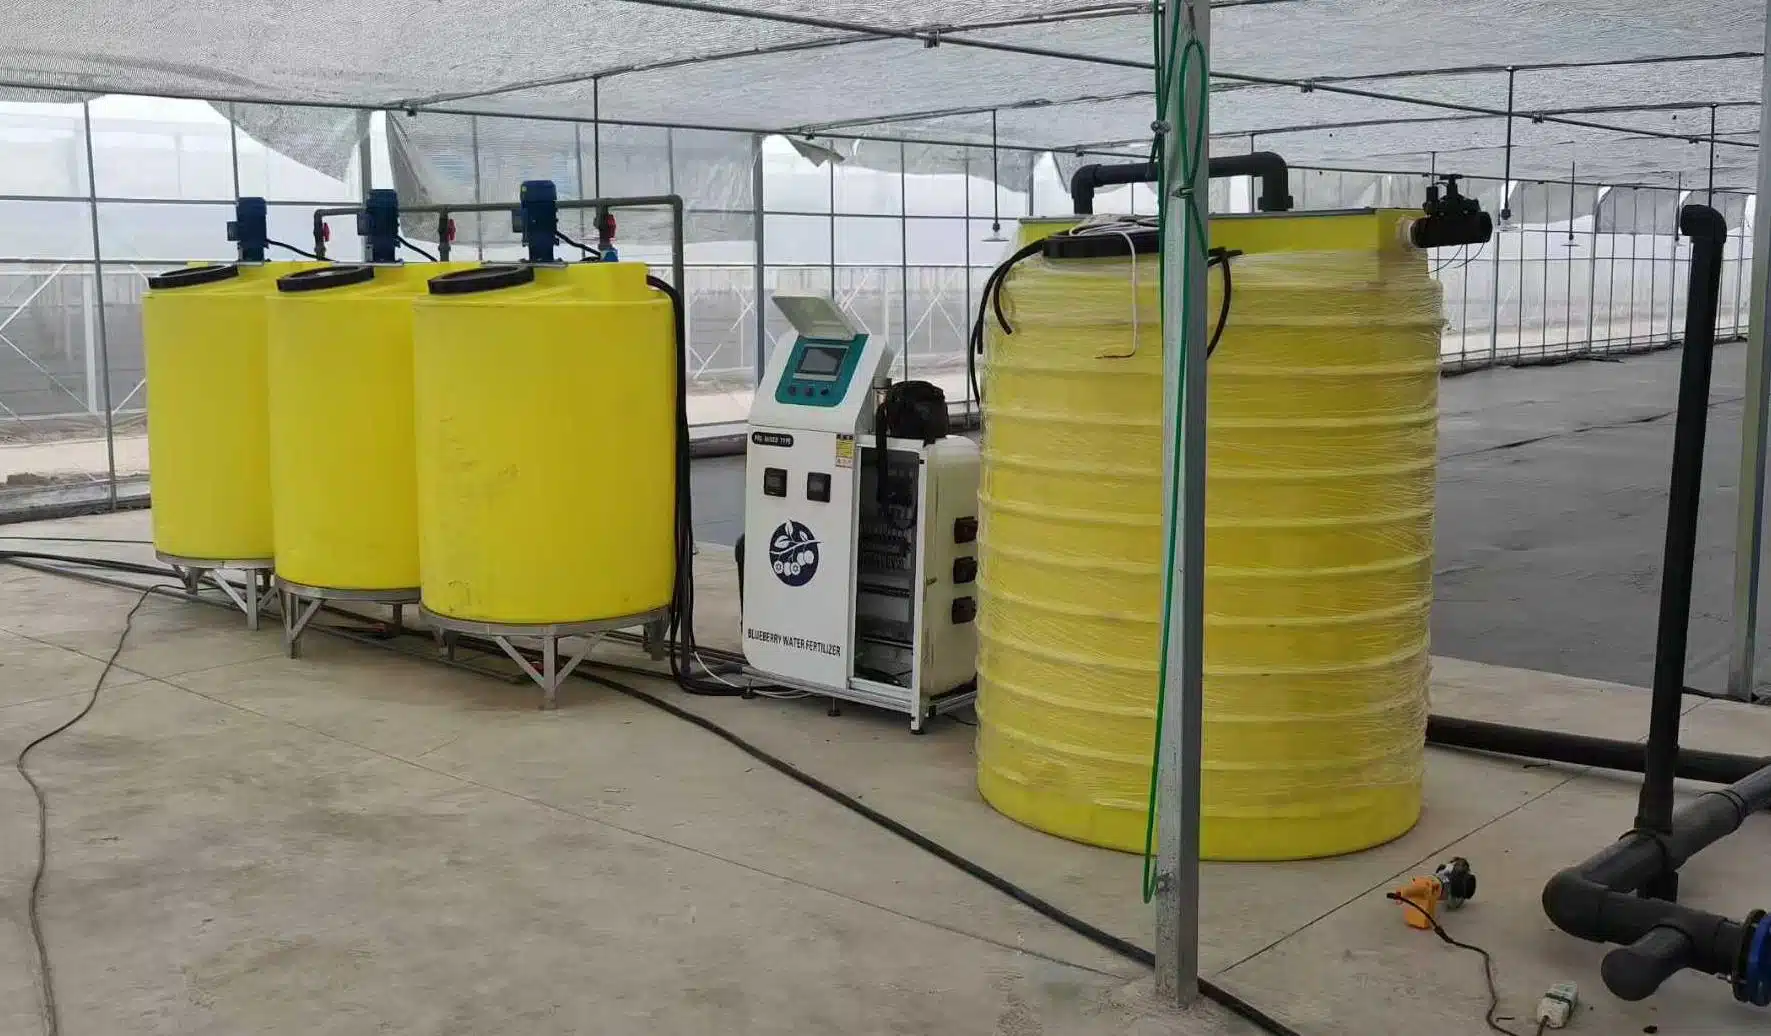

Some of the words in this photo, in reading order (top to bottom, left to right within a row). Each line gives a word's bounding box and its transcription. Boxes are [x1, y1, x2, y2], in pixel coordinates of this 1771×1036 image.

[748, 628, 782, 644] BLUEBERRY
[783, 636, 805, 650] WATER
[805, 640, 841, 656] FERTILIZER
